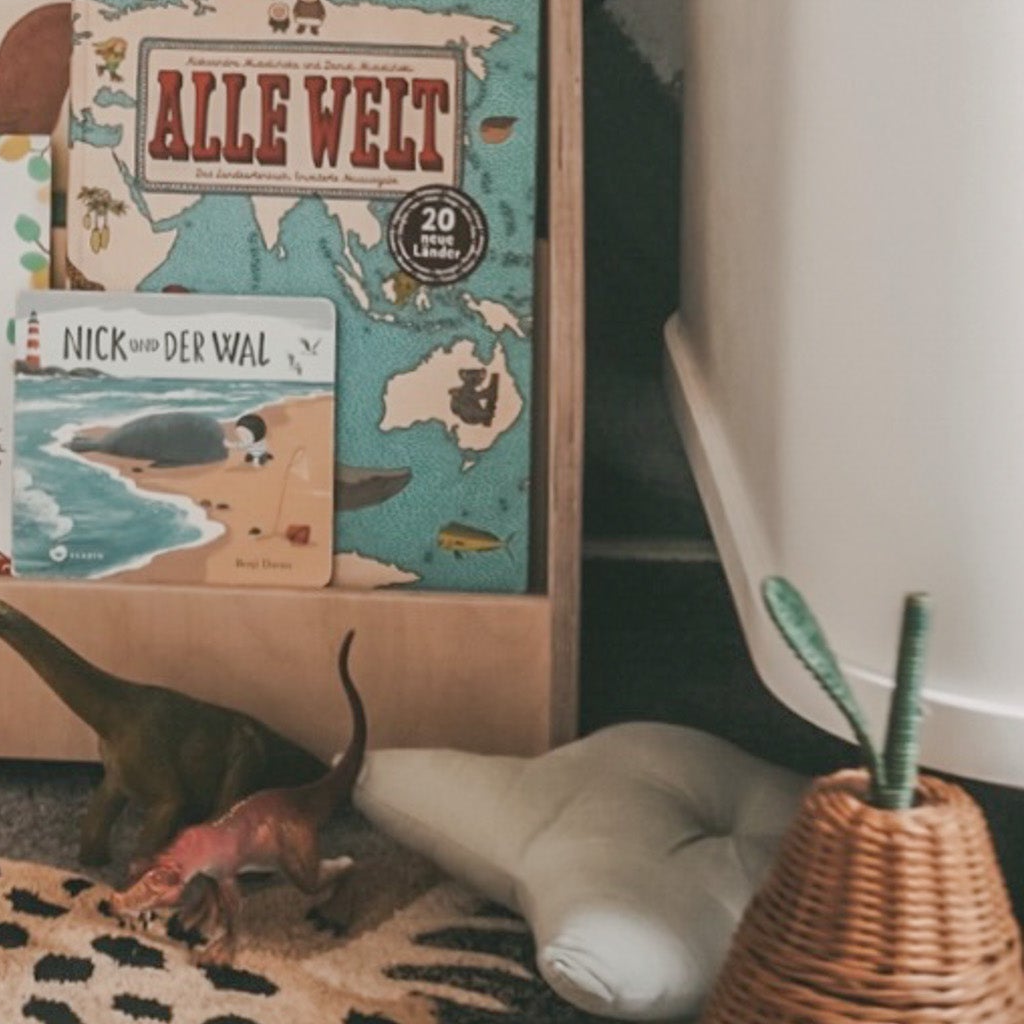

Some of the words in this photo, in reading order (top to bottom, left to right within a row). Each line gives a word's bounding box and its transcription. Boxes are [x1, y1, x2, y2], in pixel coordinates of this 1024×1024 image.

[148, 69, 290, 166] ALLE
[303, 76, 450, 172] WELT
[420, 207, 456, 232] 20
[413, 243, 461, 260] Länder
[421, 234, 455, 246] neue
[63, 326, 128, 361] NICK
[164, 330, 205, 363] DER
[211, 331, 270, 367] WAL
